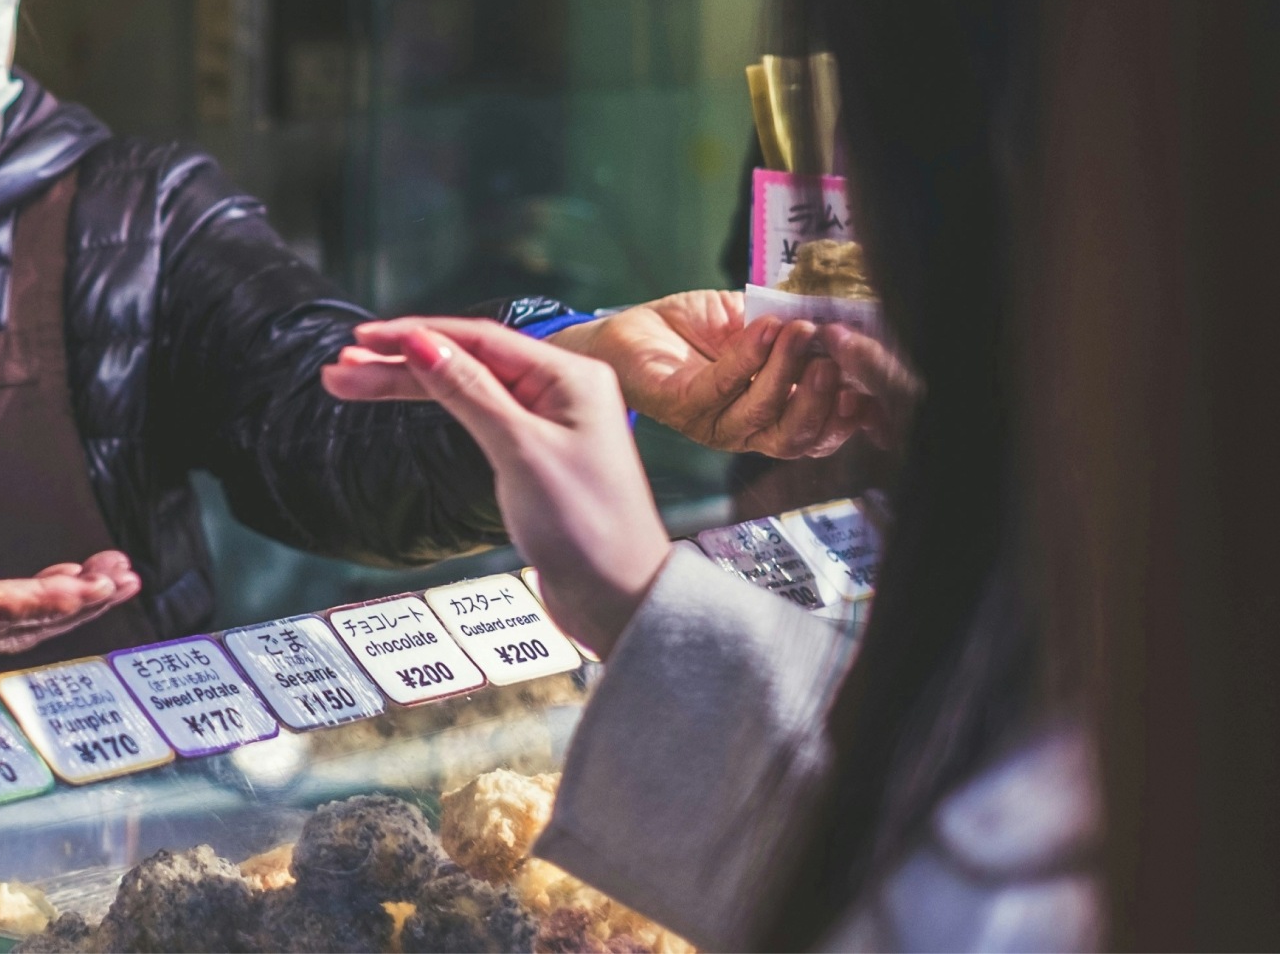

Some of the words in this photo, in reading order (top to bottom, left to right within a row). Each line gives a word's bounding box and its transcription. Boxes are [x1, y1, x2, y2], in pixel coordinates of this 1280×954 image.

[449, 587, 516, 616] カスタード
[342, 605, 426, 638] チョコレート
[460, 615, 507, 637] Custard
[505, 610, 541, 630] cream
[257, 628, 308, 657] ごま
[365, 630, 439, 657] chocolate
[494, 638, 550, 666] ¥200
[131, 647, 211, 679] さつまいも
[275, 666, 338, 688] Sesame
[395, 660, 455, 689] ¥200
[150, 690, 198, 711] Sweet
[293, 686, 357, 716] ¥150
[181, 706, 245, 737] ¥170
[73, 732, 140, 764] ¥170
